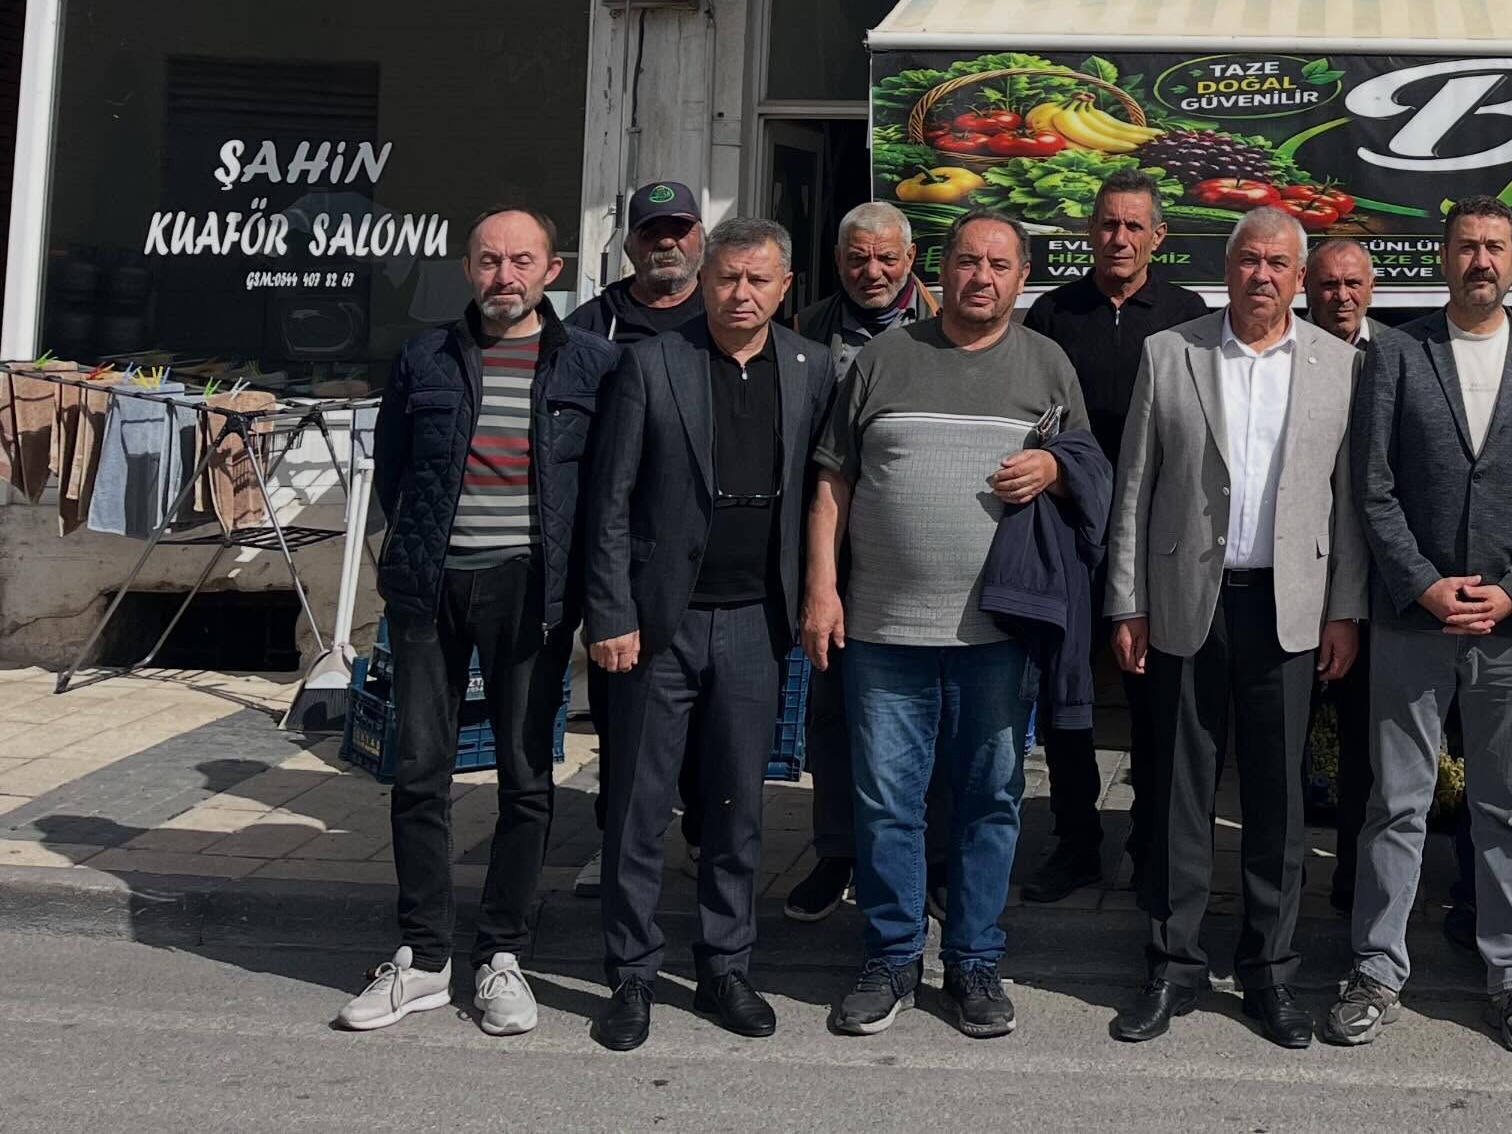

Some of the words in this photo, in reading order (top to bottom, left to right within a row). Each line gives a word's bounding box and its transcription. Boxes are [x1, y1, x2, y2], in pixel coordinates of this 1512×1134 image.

[1210, 61, 1280, 77] TAZE
[1197, 76, 1298, 95] DOĞAL
[1181, 90, 1319, 110] GÜVENİLİR
[143, 197, 289, 256] KUAFÖR
[308, 212, 449, 257] SALONU
[303, 272, 321, 287] 407
[325, 272, 338, 287] 82
[341, 272, 355, 287] 67
